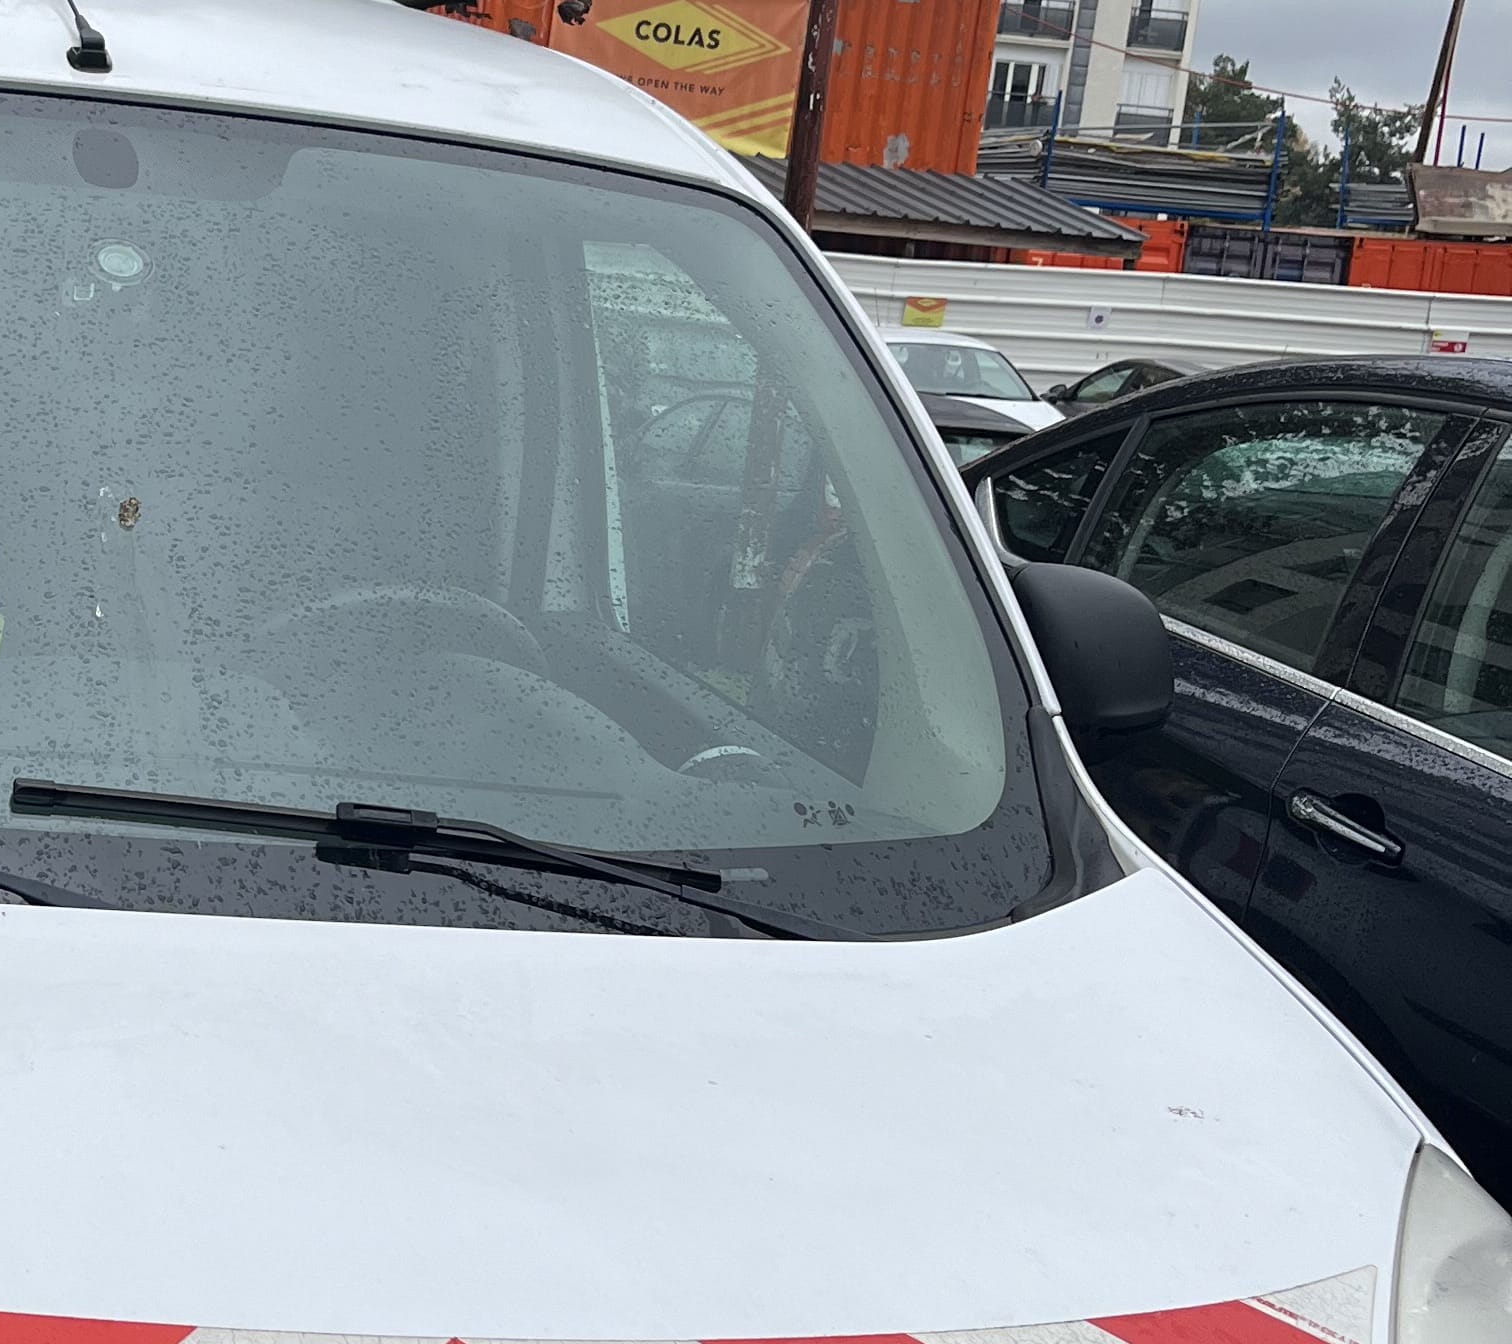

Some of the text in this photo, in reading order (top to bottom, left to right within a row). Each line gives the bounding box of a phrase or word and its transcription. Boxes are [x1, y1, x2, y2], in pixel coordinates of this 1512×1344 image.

[634, 20, 721, 50] COLAS
[638, 77, 670, 89] OPEN
[673, 81, 695, 93] THE
[699, 85, 726, 97] WAY
